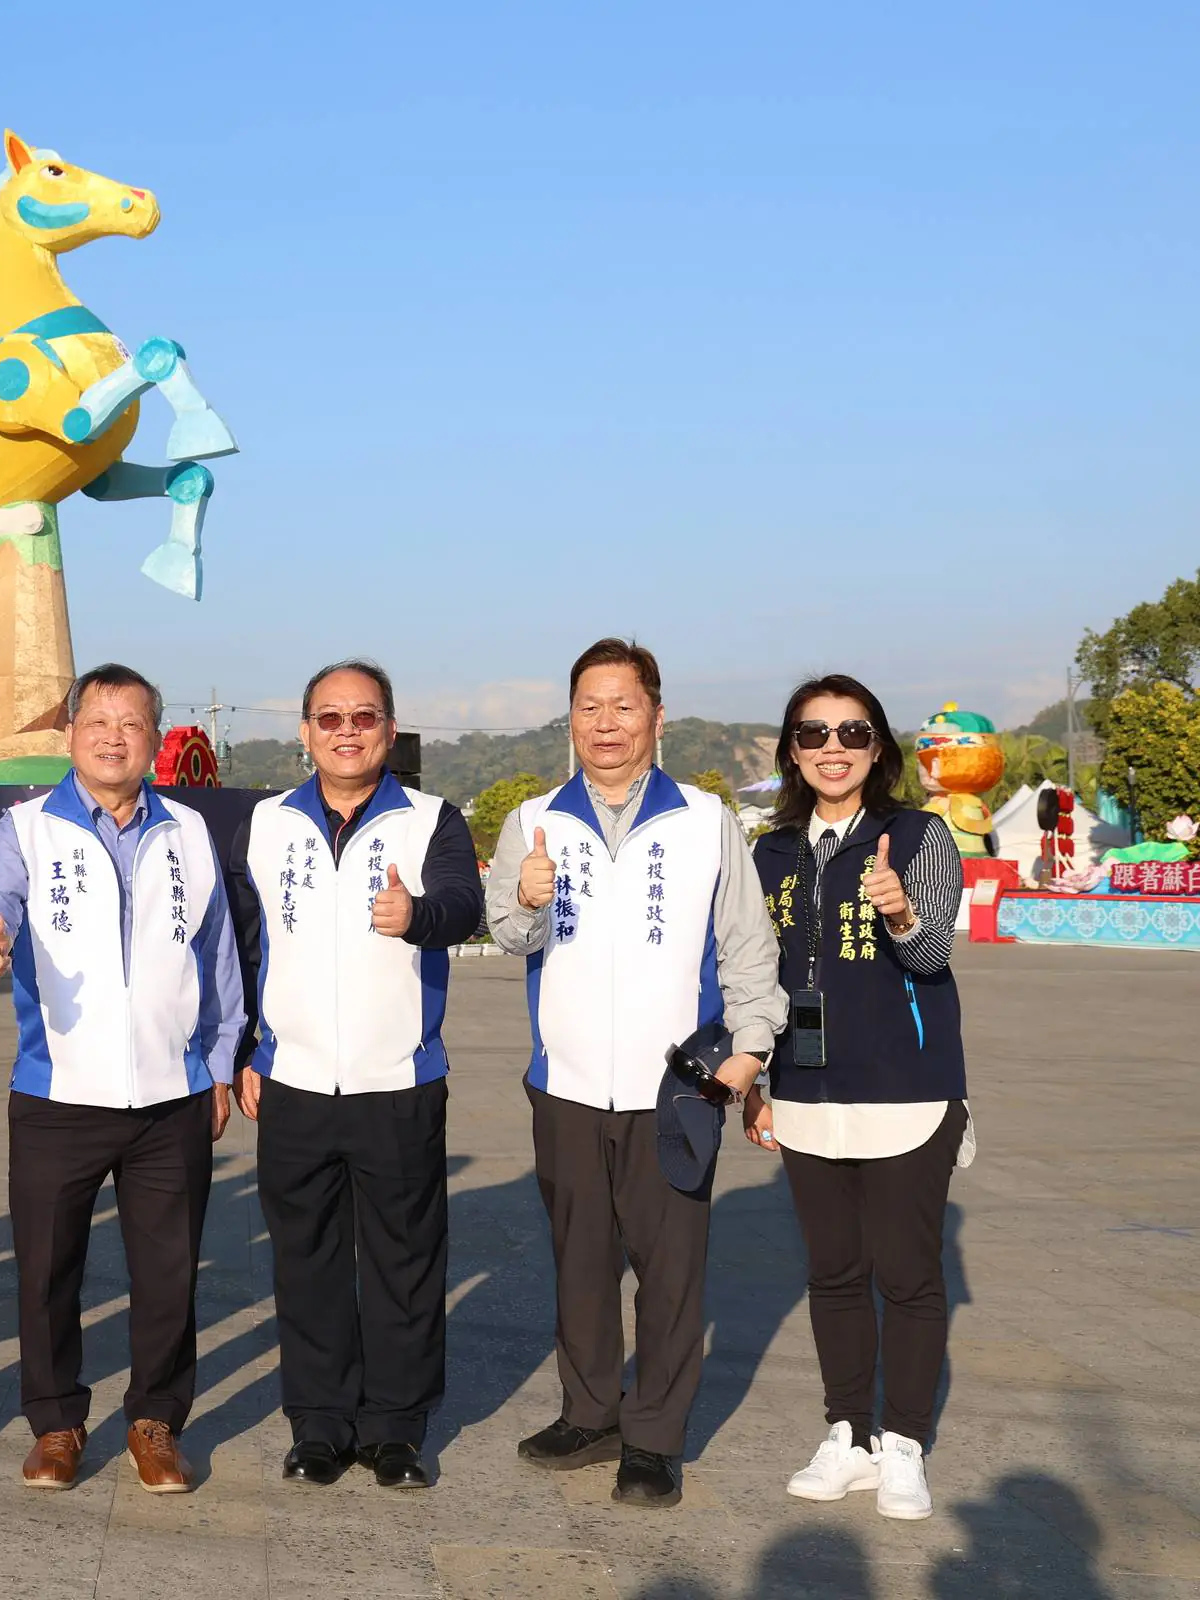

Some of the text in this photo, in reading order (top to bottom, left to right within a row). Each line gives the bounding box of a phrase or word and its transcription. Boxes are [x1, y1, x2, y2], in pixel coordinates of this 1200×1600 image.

[73, 848, 88, 893] 副縣長
[301, 837, 319, 890] 觀光處
[367, 837, 385, 933] 南投縣
[579, 842, 594, 898] 政風處
[646, 841, 666, 945] 南投縣政府
[50, 861, 73, 933] 王瑞德
[166, 848, 187, 944] 南投縣政府
[778, 874, 797, 928] 副局長
